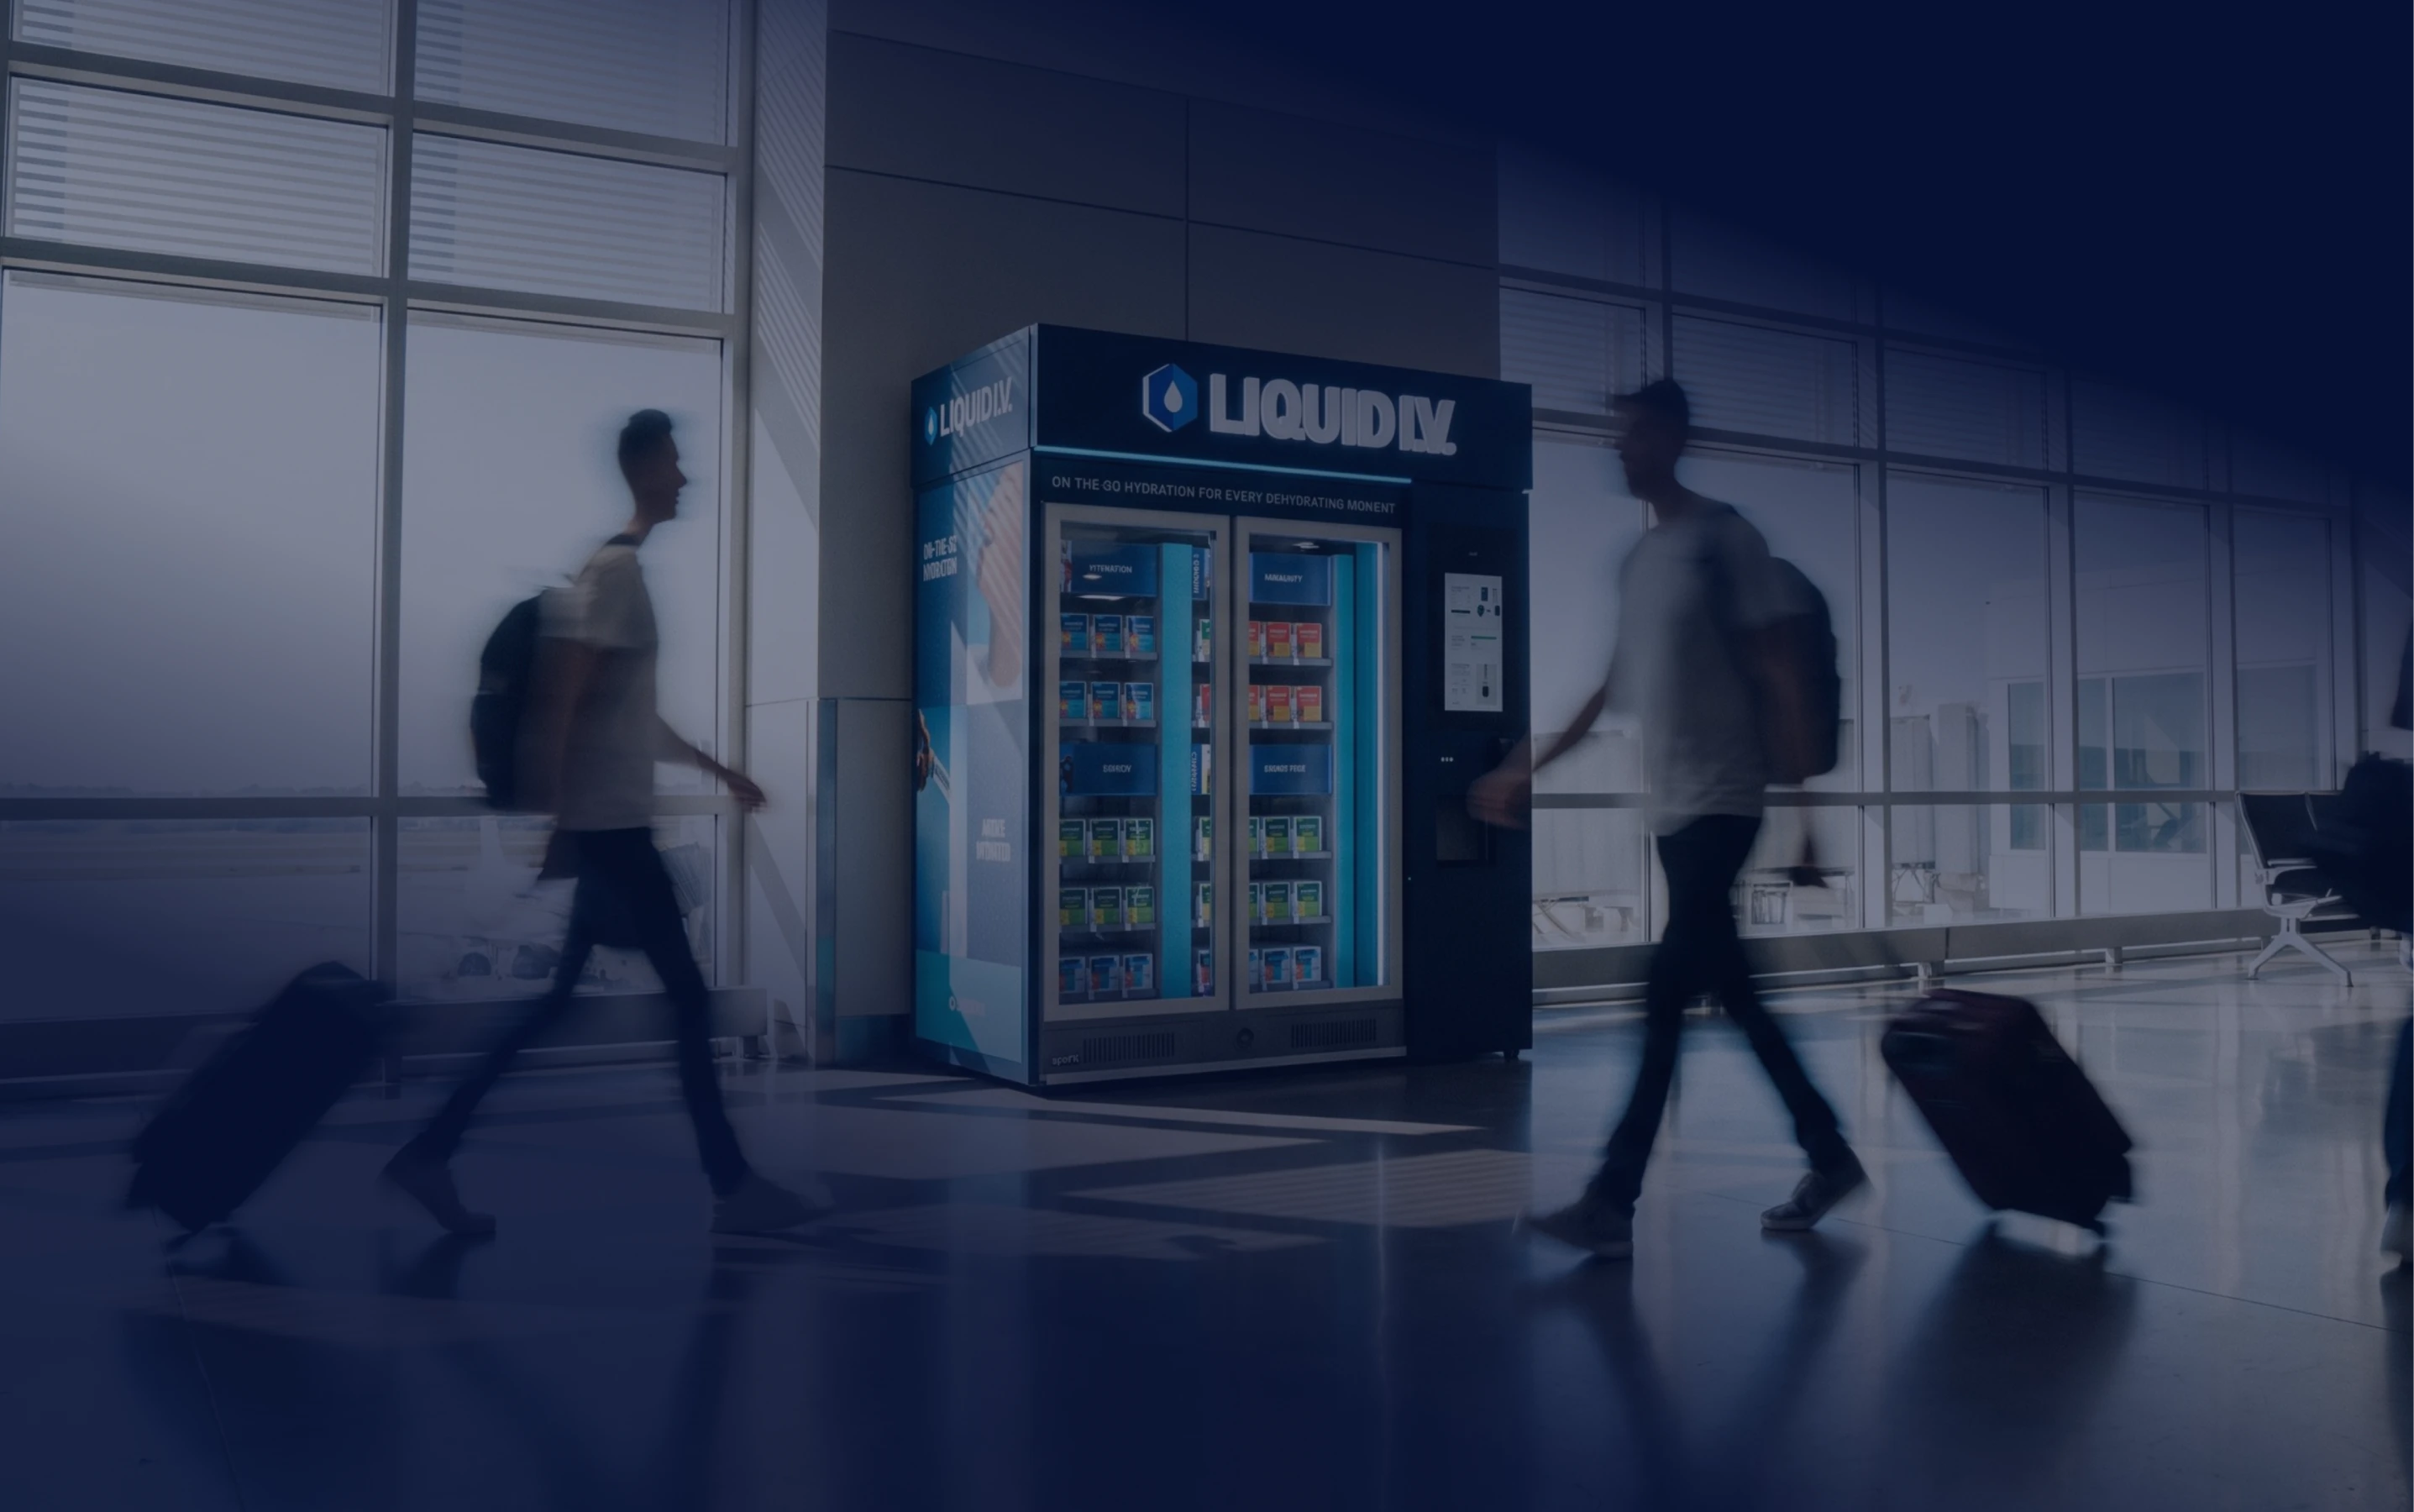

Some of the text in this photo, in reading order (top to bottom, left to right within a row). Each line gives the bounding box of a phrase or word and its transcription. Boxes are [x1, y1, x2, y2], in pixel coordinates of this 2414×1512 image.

[940, 386, 992, 438] LIQUID
[1210, 373, 1396, 449] LIQUID
[1052, 475, 1071, 488] ON
[1074, 477, 1100, 491] THE
[1125, 481, 1195, 498] HYDRATION
[1199, 486, 1222, 500] FOR
[1225, 489, 1263, 504] EVERY
[1266, 492, 1344, 511] DEHYDRATING
